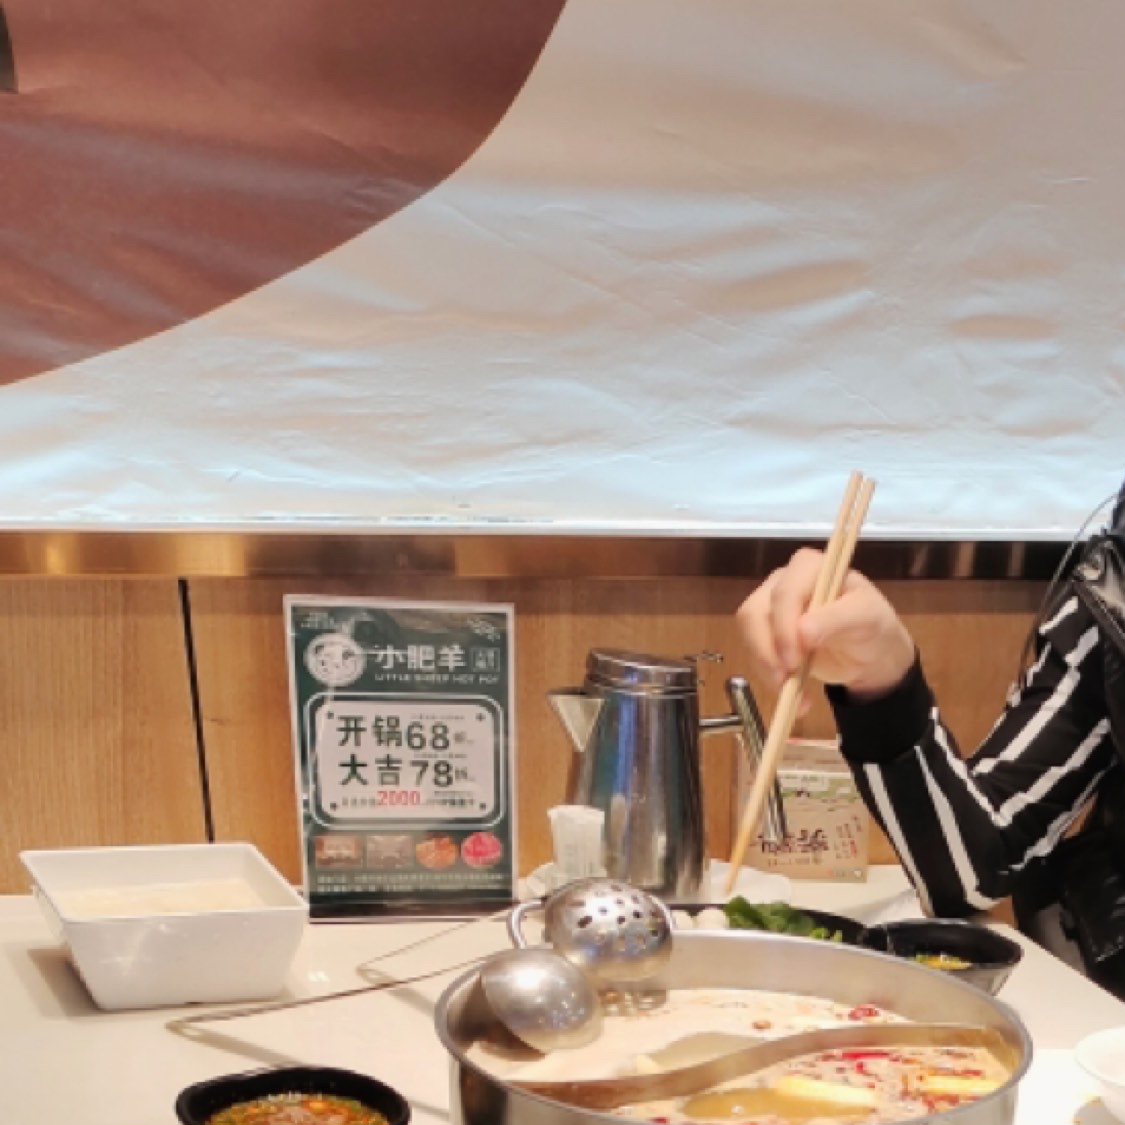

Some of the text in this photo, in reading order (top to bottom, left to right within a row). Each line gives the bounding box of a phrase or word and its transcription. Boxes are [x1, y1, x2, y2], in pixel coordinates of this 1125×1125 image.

[373, 644, 467, 672] 小肥羊
[376, 789, 422, 807] 2000
